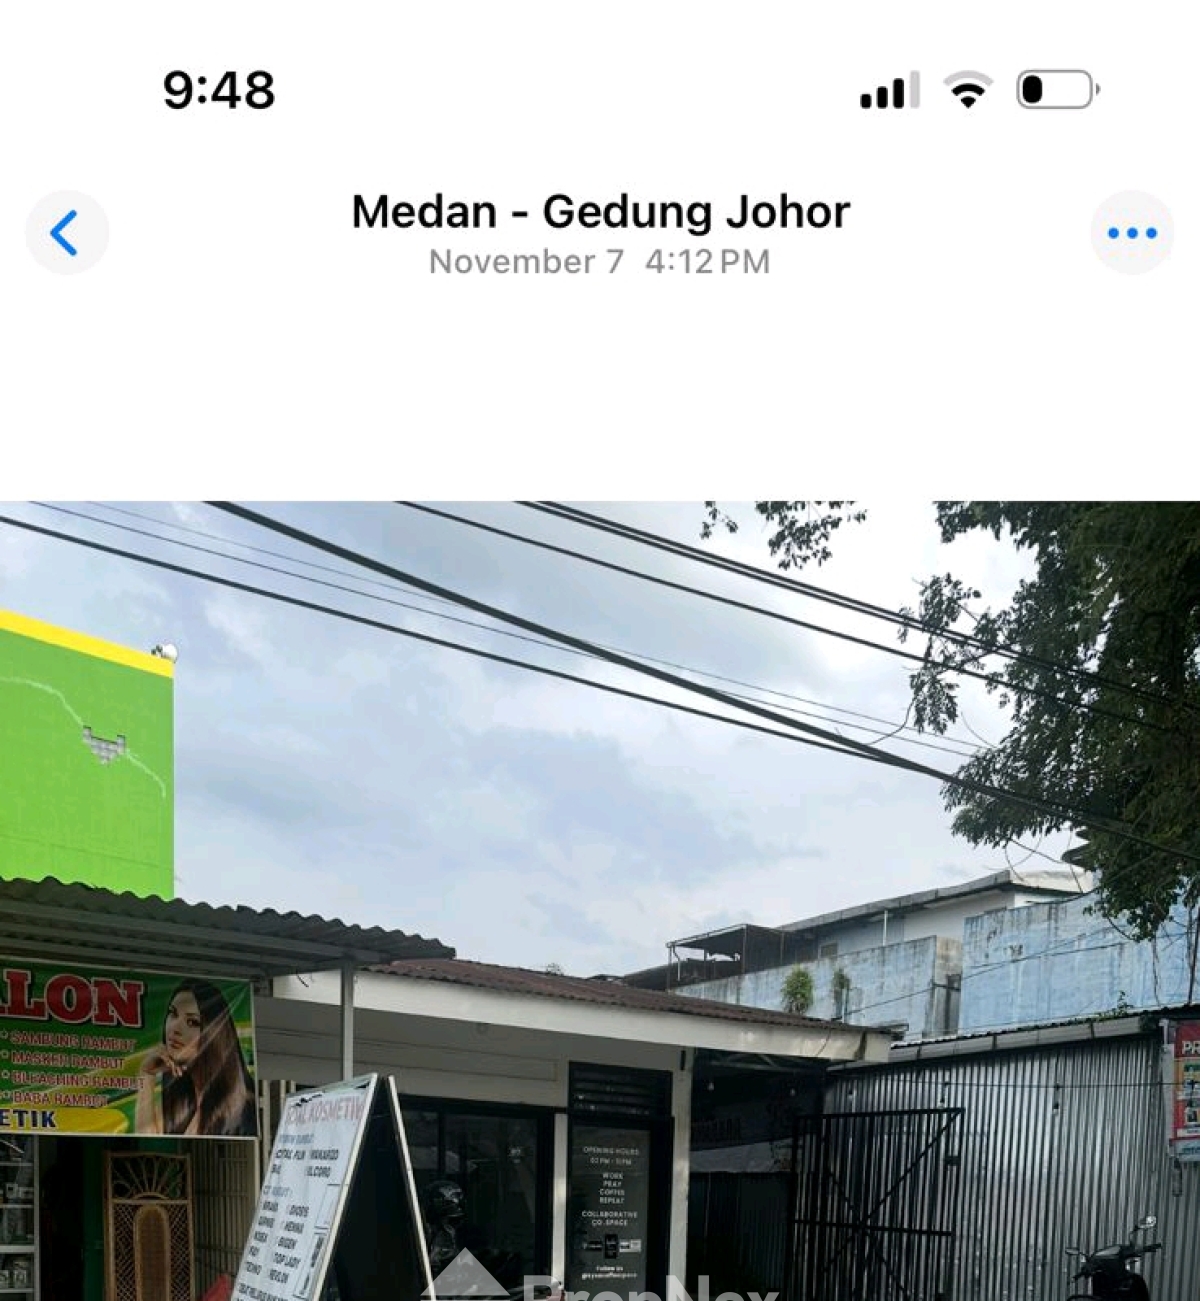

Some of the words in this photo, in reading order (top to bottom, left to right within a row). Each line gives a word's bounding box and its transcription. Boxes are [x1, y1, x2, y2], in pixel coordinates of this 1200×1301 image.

[164, 71, 274, 109] 9:48
[354, 193, 495, 228] Medan
[544, 193, 711, 236] Gedung
[727, 193, 850, 228] Johor
[430, 249, 595, 273] November
[607, 249, 623, 273] 7
[0, 969, 144, 1028] LON
[11, 1030, 79, 1048] SAMBUNG
[81, 1036, 136, 1052] RAMBUT
[11, 1051, 71, 1068] MASKER
[72, 1054, 124, 1071] RAMBUT
[12, 1070, 93, 1087] BLEACHING
[93, 1075, 146, 1090] RAMBUT
[583, 1146, 613, 1154] OPENING
[615, 1148, 639, 1156] HOURS
[599, 1188, 625, 1196] COFFEE
[599, 1196, 625, 1204] REPEAT
[581, 1210, 638, 1218] COLLABORATIVE
